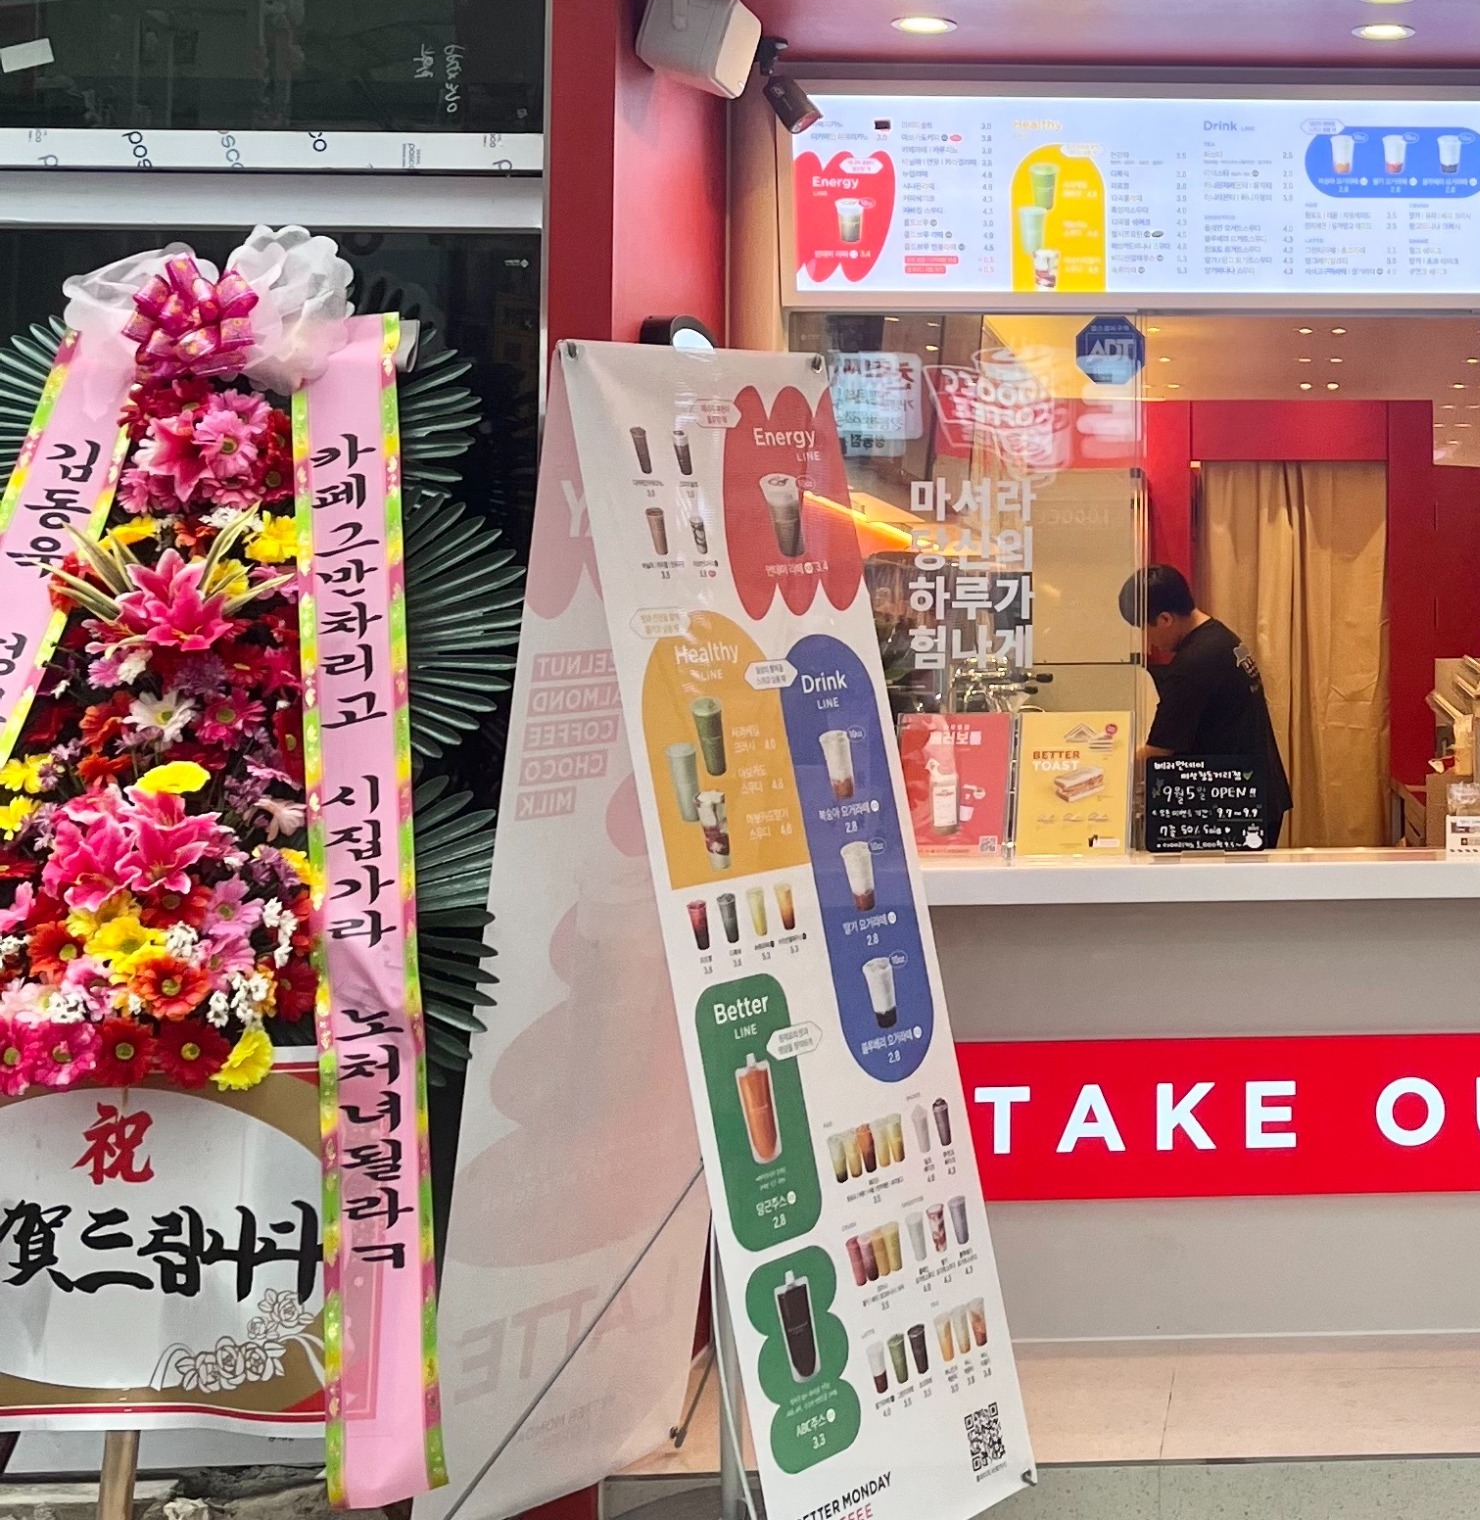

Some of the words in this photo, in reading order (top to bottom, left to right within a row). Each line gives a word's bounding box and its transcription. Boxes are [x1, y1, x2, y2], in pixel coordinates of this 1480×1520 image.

[1013, 119, 1062, 131] Healthy
[1203, 120, 1238, 131] Drink
[812, 176, 859, 190] Energy
[753, 427, 816, 449] Energy
[796, 451, 822, 462] LINE
[910, 477, 1037, 522] 마셔라
[908, 575, 1035, 620] 하루가
[673, 640, 739, 665] Healthy
[909, 624, 1034, 670] 힘나게
[701, 668, 724, 681] LINE
[801, 669, 848, 694] Drink
[816, 696, 840, 710] LINE
[1032, 750, 1081, 760] BETTER
[1032, 760, 1081, 772] TOAST
[1162, 785, 1184, 805] 9월
[1210, 786, 1247, 799] OPEN
[844, 820, 859, 834] 2.8
[1180, 824, 1200, 835] 50%
[865, 932, 880, 946] 2.8
[713, 995, 769, 1025] Better
[733, 1023, 758, 1040] LINE
[887, 1049, 901, 1064] 2.8
[974, 1079, 1299, 1155] TAKE
[71, 1102, 155, 1185] 祝
[772, 1212, 787, 1229] 2.8
[812, 1432, 827, 1451] 3.3
[798, 1498, 841, 1520] ETTER
[841, 1470, 892, 1510] MONDAY
